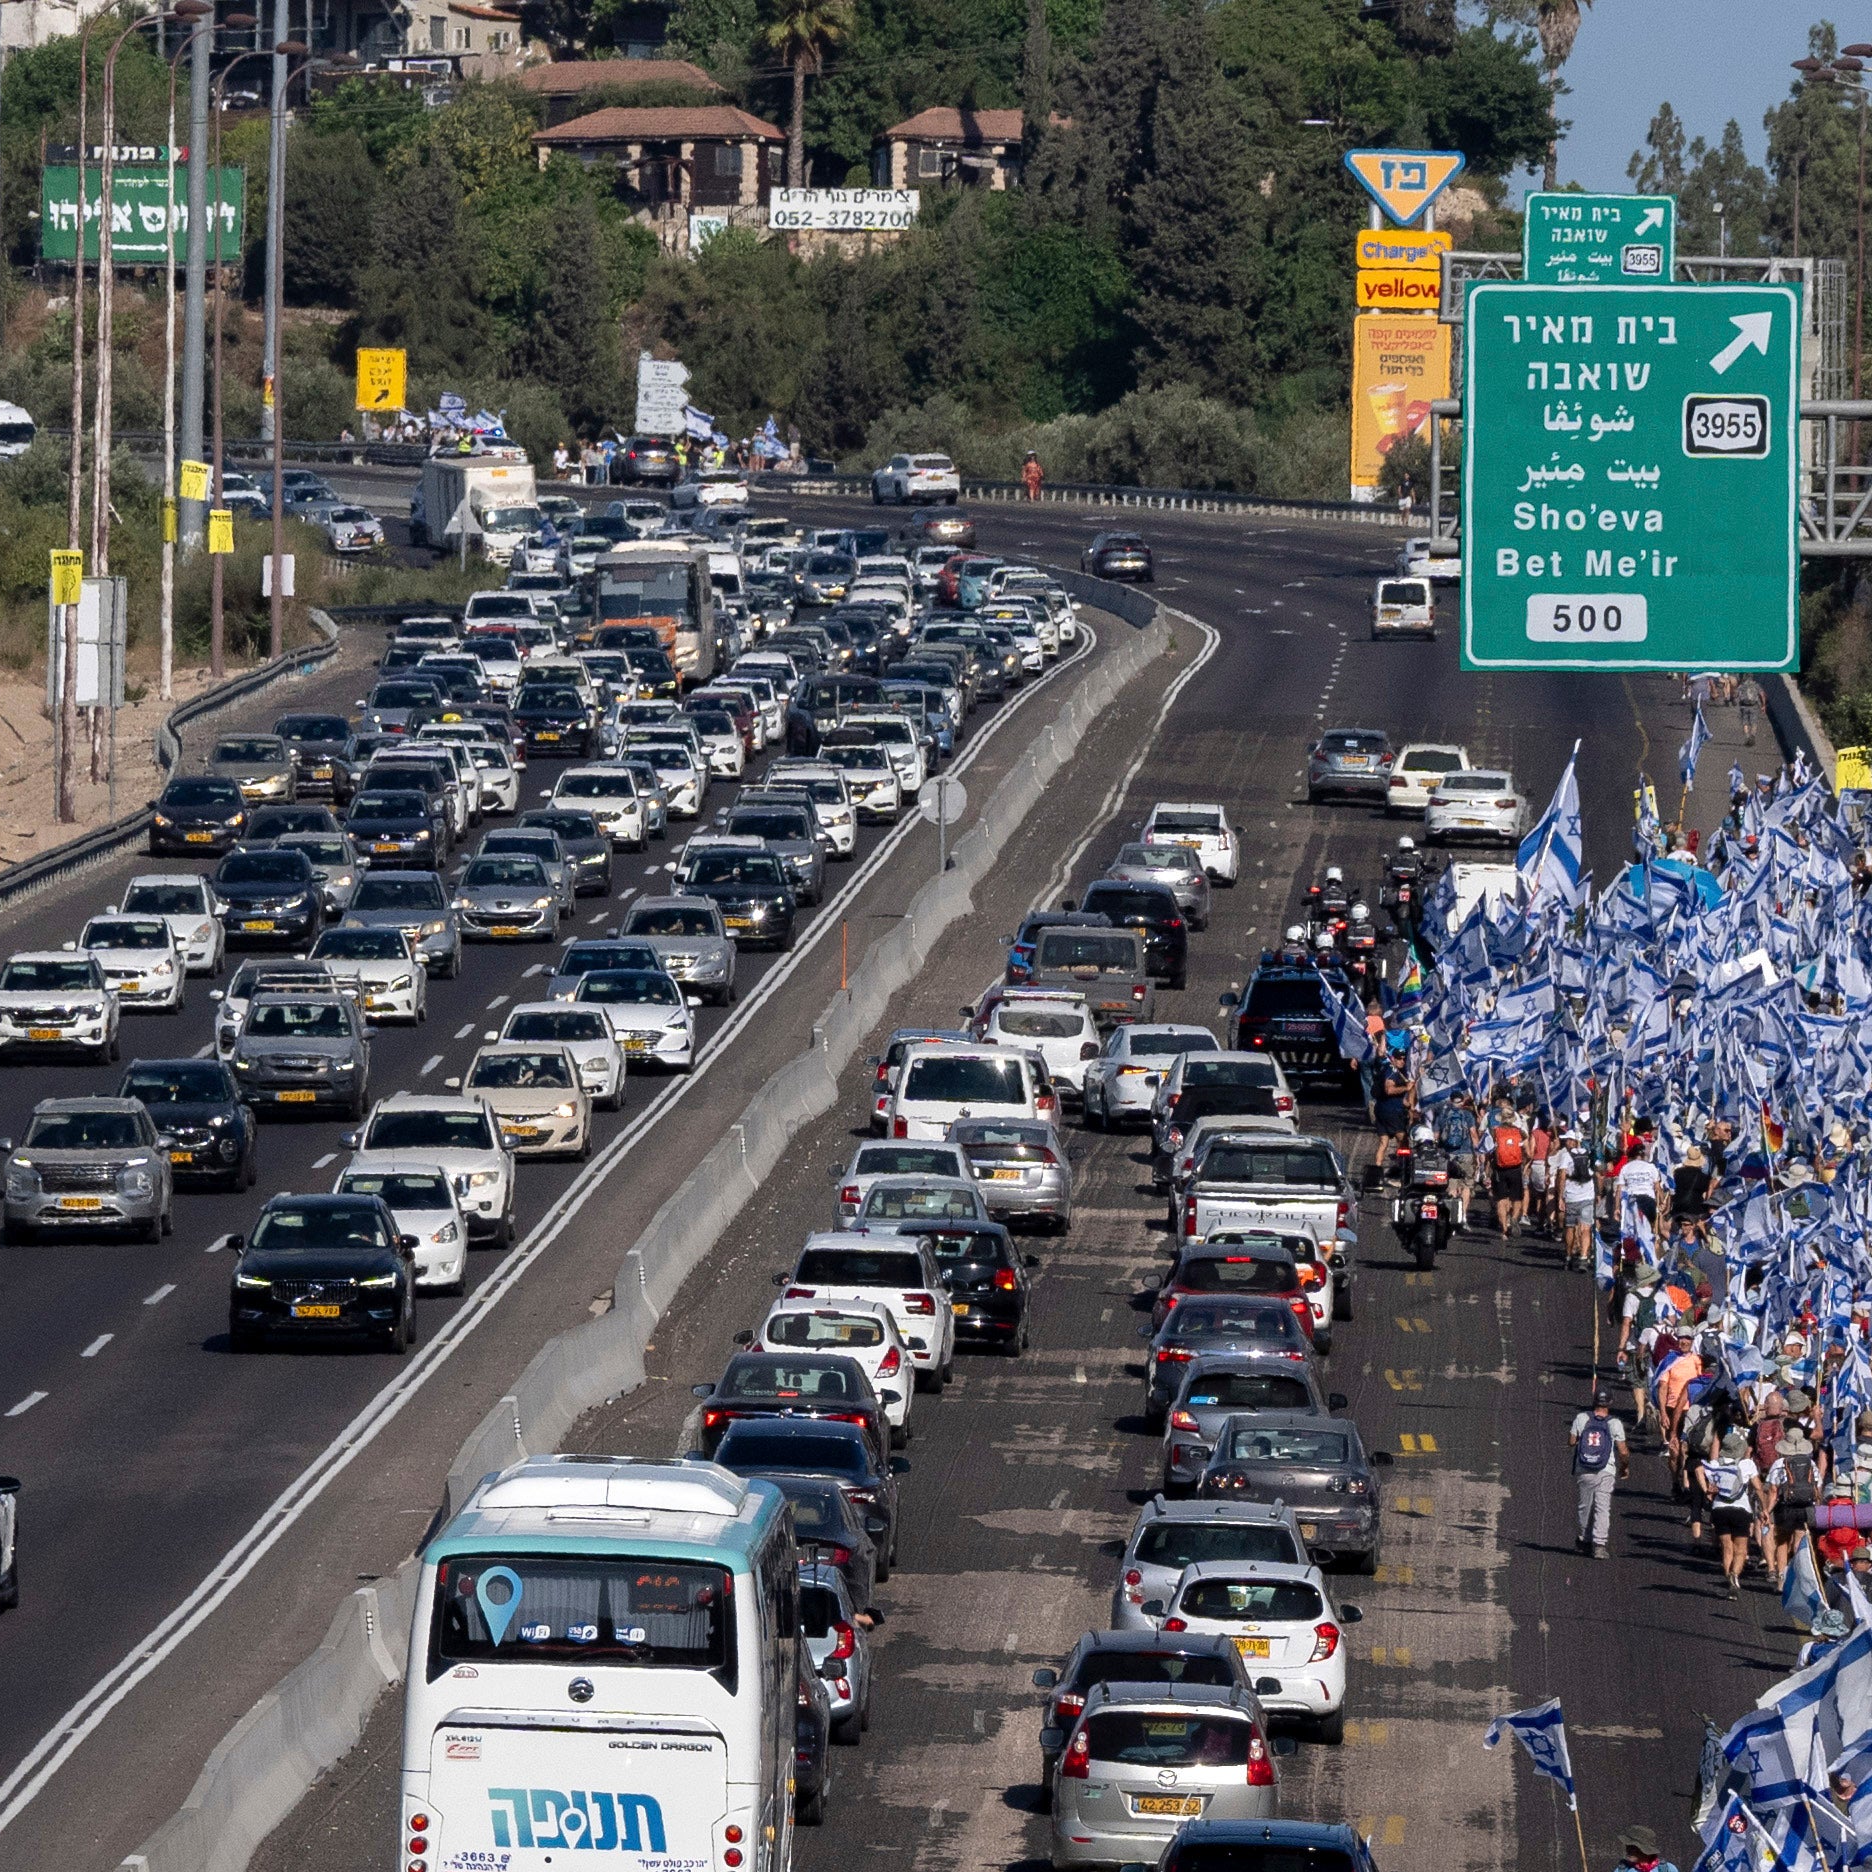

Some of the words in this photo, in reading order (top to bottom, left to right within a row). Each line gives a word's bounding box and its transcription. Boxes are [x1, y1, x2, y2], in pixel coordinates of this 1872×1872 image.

[1380, 159, 1428, 191] פז
[1540, 205, 1582, 221] מאיר
[1551, 227, 1608, 243] שואבה
[1628, 253, 1656, 266] 3955
[1364, 277, 1440, 300] yellow
[1503, 315, 1593, 345] מאיר
[1616, 315, 1679, 345] בית
[1527, 361, 1652, 392] שואבה
[1695, 412, 1758, 439] 3955
[1606, 459, 1662, 490] بيت
[1495, 547, 1564, 578] Bet
[1552, 604, 1623, 633] 500
[608, 1740, 658, 1751] GOLDEN
[660, 1742, 713, 1753] DRAGON
[488, 1787, 668, 1853] תנופה
